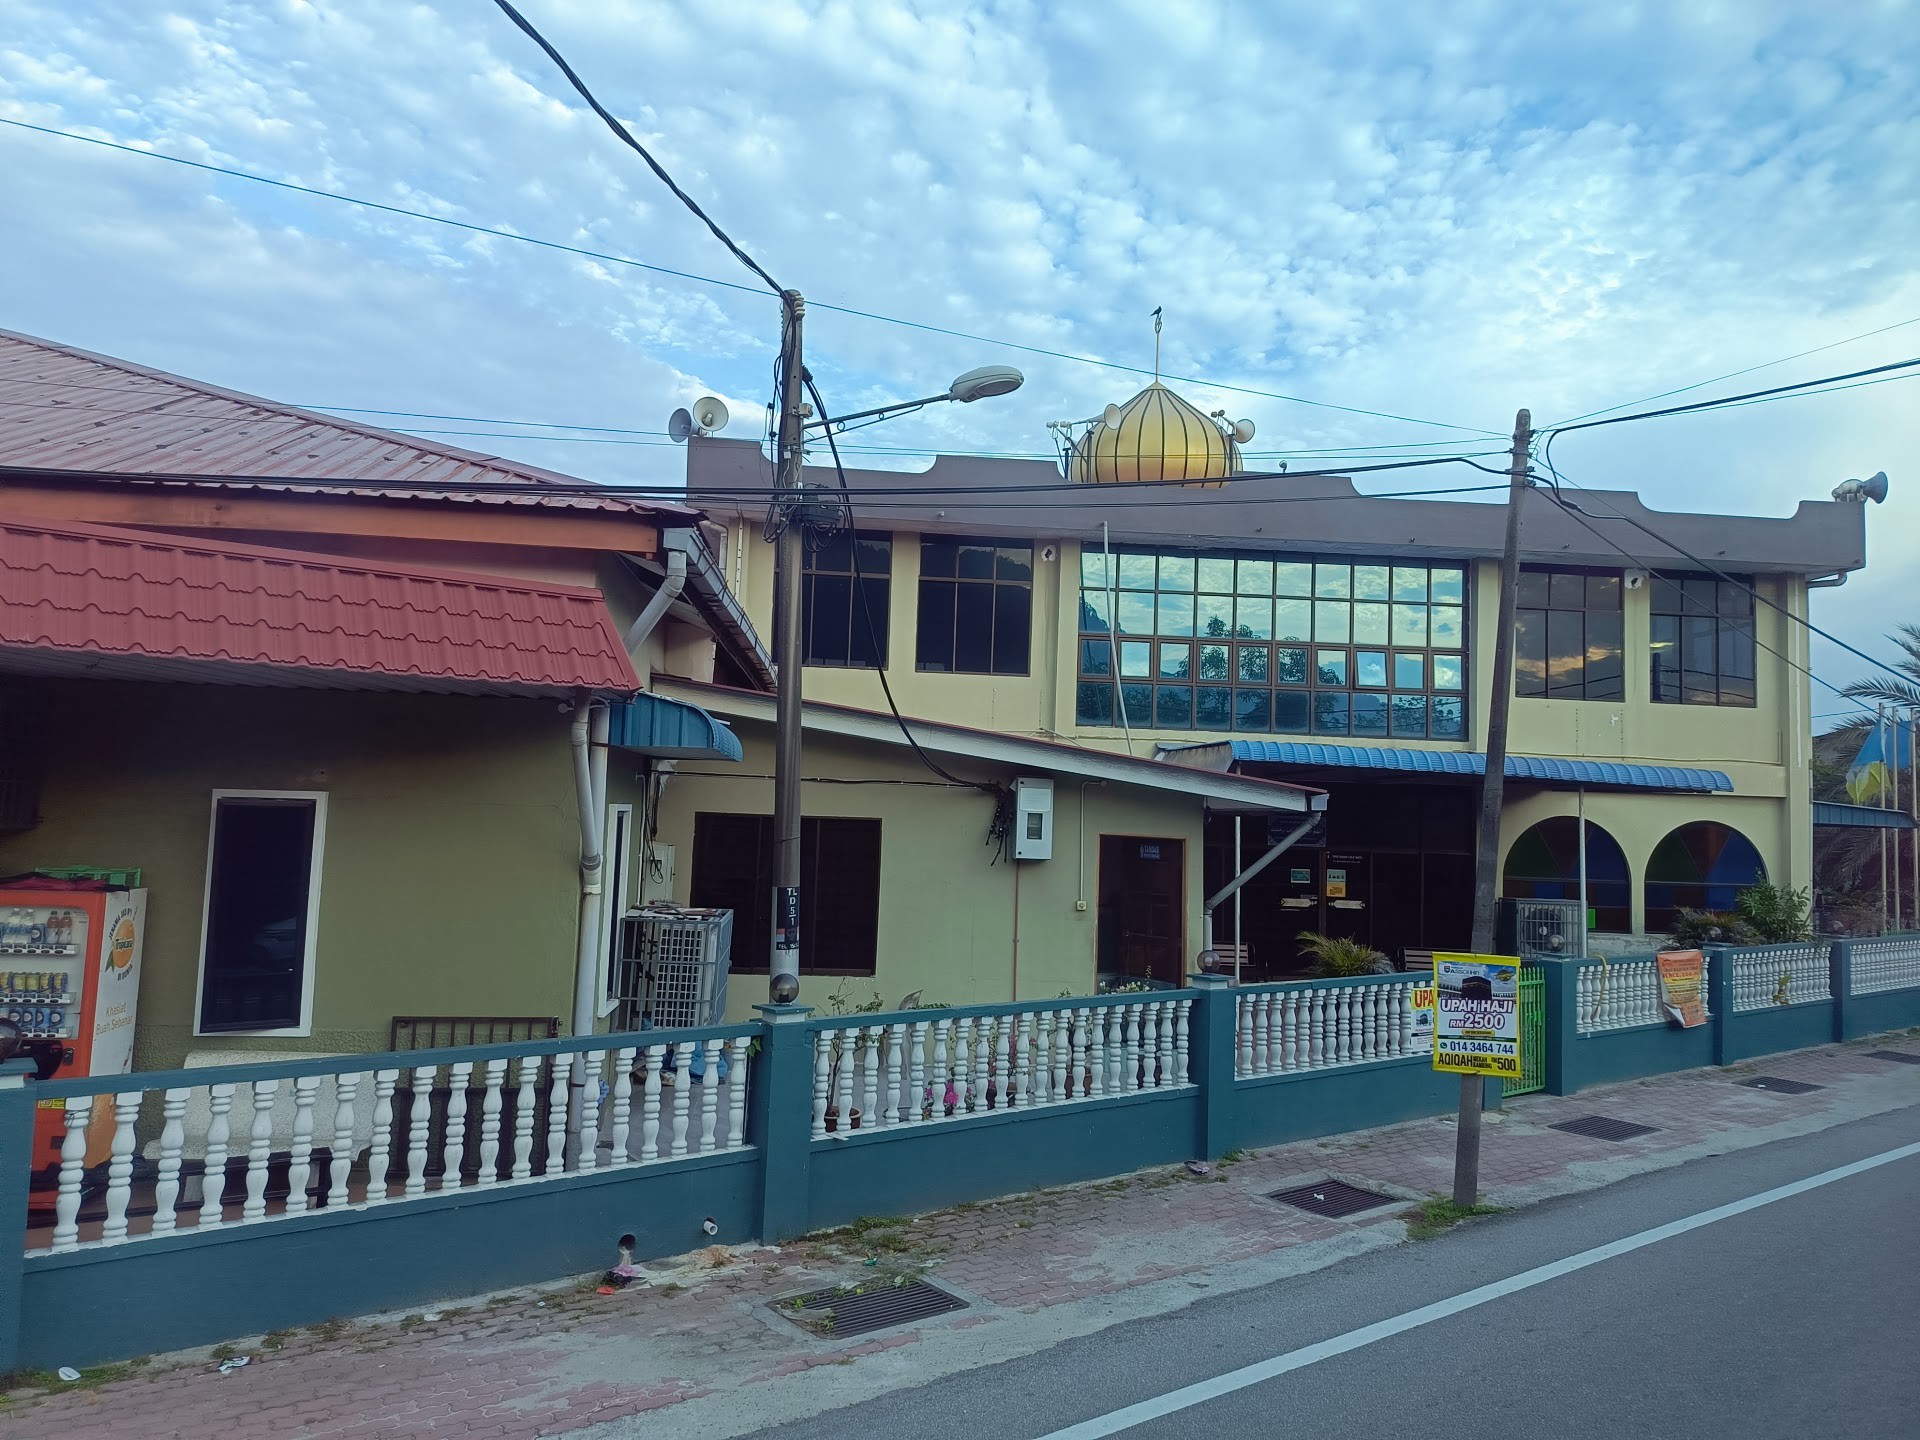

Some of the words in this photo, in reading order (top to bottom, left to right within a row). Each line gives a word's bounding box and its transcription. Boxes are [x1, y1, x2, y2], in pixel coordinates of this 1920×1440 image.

[787, 887, 798, 896] TL
[789, 896, 796, 905] D
[115, 938, 134, 950] Tropicana
[106, 1002, 127, 1018] Khasiat
[1440, 999, 1479, 1012] UPAH
[1479, 1000, 1514, 1013] HAJI
[95, 1022, 111, 1036] Buah
[1450, 1041, 1467, 1052] 014
[1470, 1042, 1494, 1053] 3464
[1497, 1044, 1514, 1055] 744
[1438, 1053, 1473, 1067] AQIQAH
